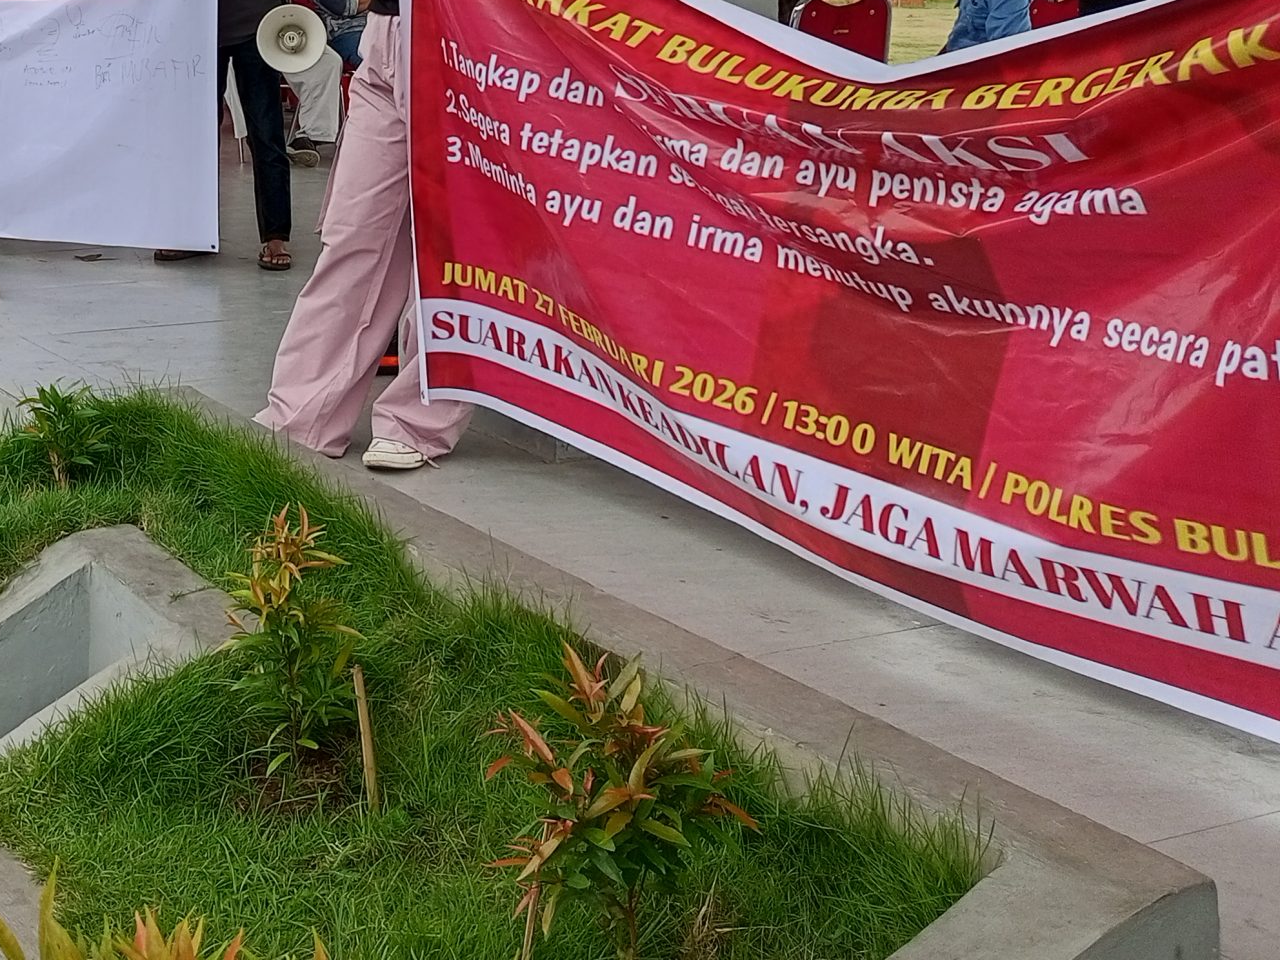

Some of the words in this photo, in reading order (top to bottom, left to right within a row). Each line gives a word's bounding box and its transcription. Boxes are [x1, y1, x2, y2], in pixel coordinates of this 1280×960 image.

[656, 34, 955, 111] BULUKUMBA
[960, 22, 1280, 111] BERGERAK
[519, 122, 659, 179] tetapkan
[667, 161, 759, 222] seagai
[759, 207, 935, 267] tersangka.
[552, 68, 605, 107] dan
[720, 138, 784, 179] dan
[795, 158, 857, 198] ayu
[869, 168, 1005, 214] penista
[1015, 187, 1148, 226] agama
[545, 190, 603, 227] ayu
[613, 195, 674, 241] dan
[686, 213, 764, 264] irma
[777, 243, 914, 313] menutup
[928, 284, 1091, 347] akunnya
[1103, 317, 1210, 369] secara
[441, 260, 528, 305] JUMAT
[531, 287, 555, 317] 27
[557, 302, 665, 388] FEBRUARI
[668, 364, 759, 416] 2026
[782, 398, 876, 456] 13:00
[886, 432, 973, 492] WITA
[1001, 471, 1162, 545] POLRES
[1173, 518, 1280, 570] BUL
[819, 483, 942, 561] JAGA
[951, 527, 1251, 645] MARWAH
